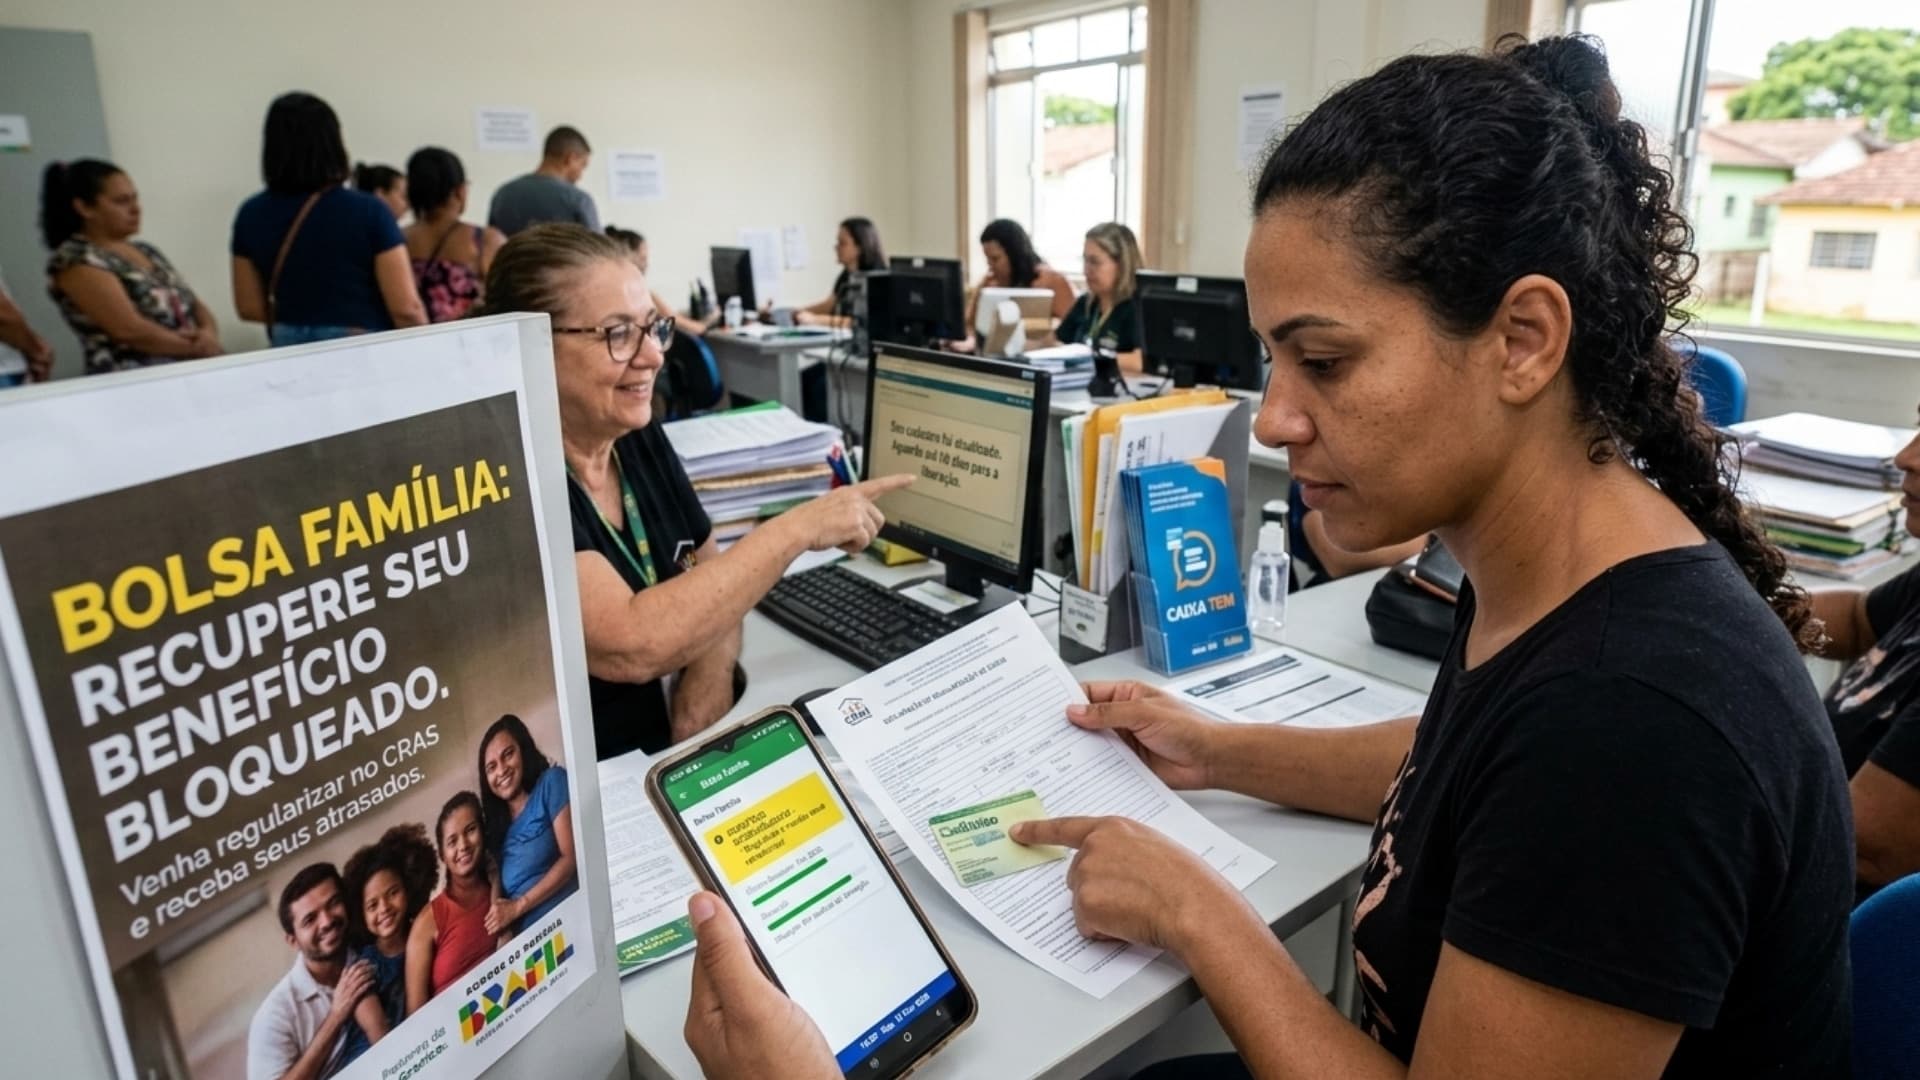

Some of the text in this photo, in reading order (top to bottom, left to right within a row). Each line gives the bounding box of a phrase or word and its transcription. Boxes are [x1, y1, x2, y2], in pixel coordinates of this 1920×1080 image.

[51, 459, 512, 653] BOLSA FAMÍLIA:
[71, 529, 471, 727] RECUPERE SEU
[1166, 592, 1235, 623] CAIXA TEM
[88, 627, 386, 797] BENEFÍCIO
[104, 665, 450, 863] BLOQUEADO.
[120, 724, 441, 906] Venha regularizar no CRAS
[129, 765, 426, 940] e receba seus atrasados.
